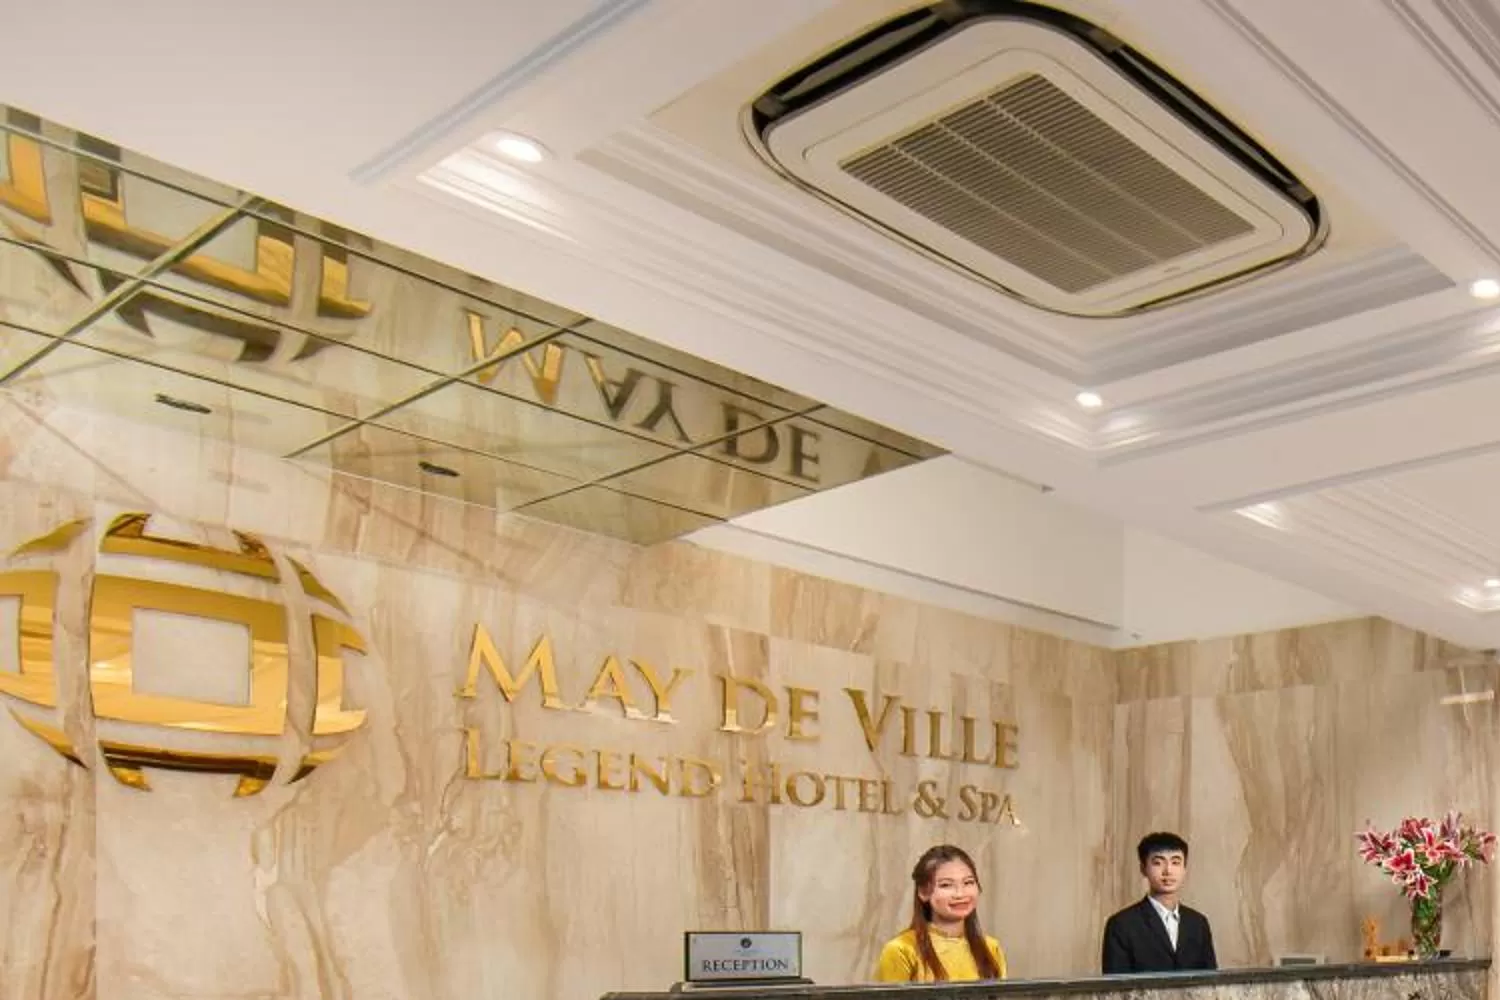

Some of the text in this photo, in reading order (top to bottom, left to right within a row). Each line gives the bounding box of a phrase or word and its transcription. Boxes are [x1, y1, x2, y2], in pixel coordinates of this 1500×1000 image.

[454, 622, 1021, 769] MAY DE VILLE
[461, 725, 1022, 827] LEGEND HOTEL & SPA
[702, 958, 789, 973] RECEPTION
